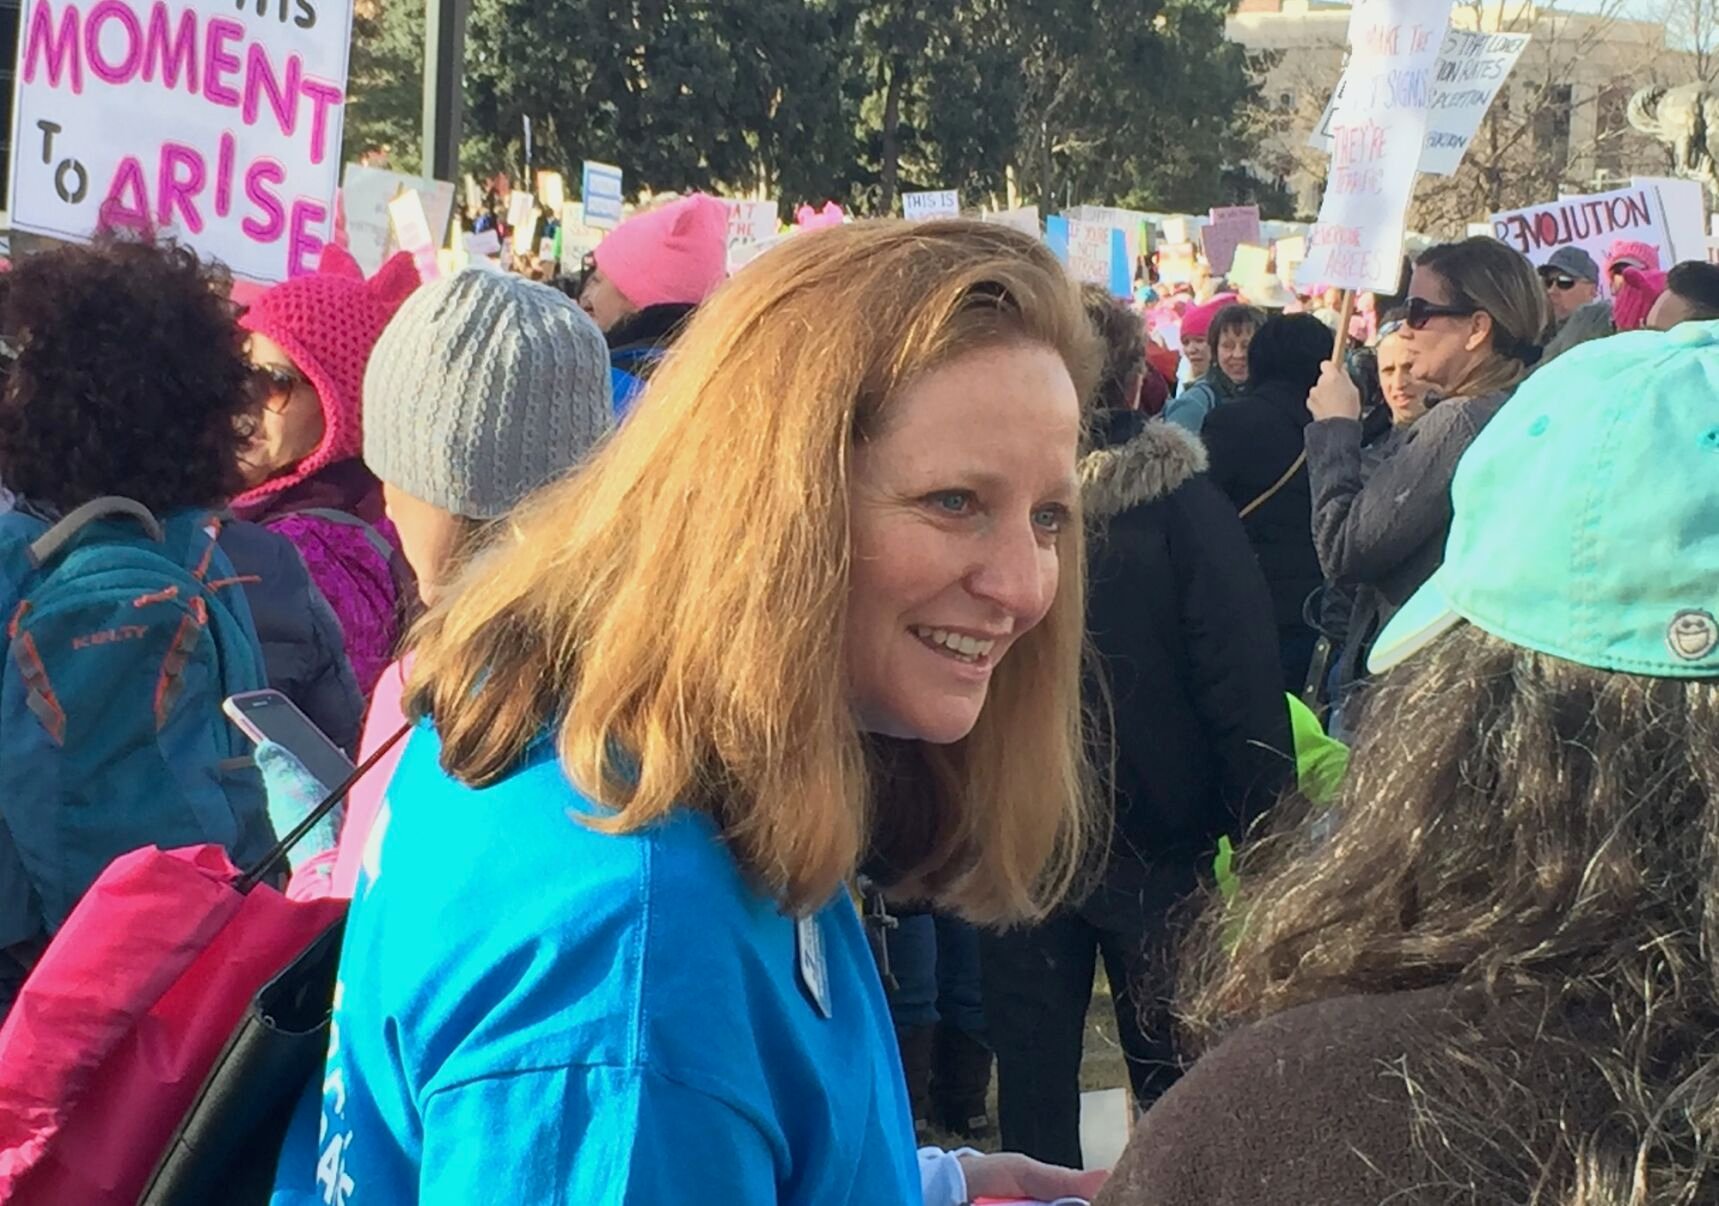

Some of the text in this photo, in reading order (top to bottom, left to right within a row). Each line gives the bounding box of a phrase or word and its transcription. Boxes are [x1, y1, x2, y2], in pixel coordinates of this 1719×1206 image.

[23, 0, 343, 165] MOMENT
[36, 119, 89, 205] TO
[98, 130, 329, 277] ARISE
[906, 192, 955, 209] THIS IS
